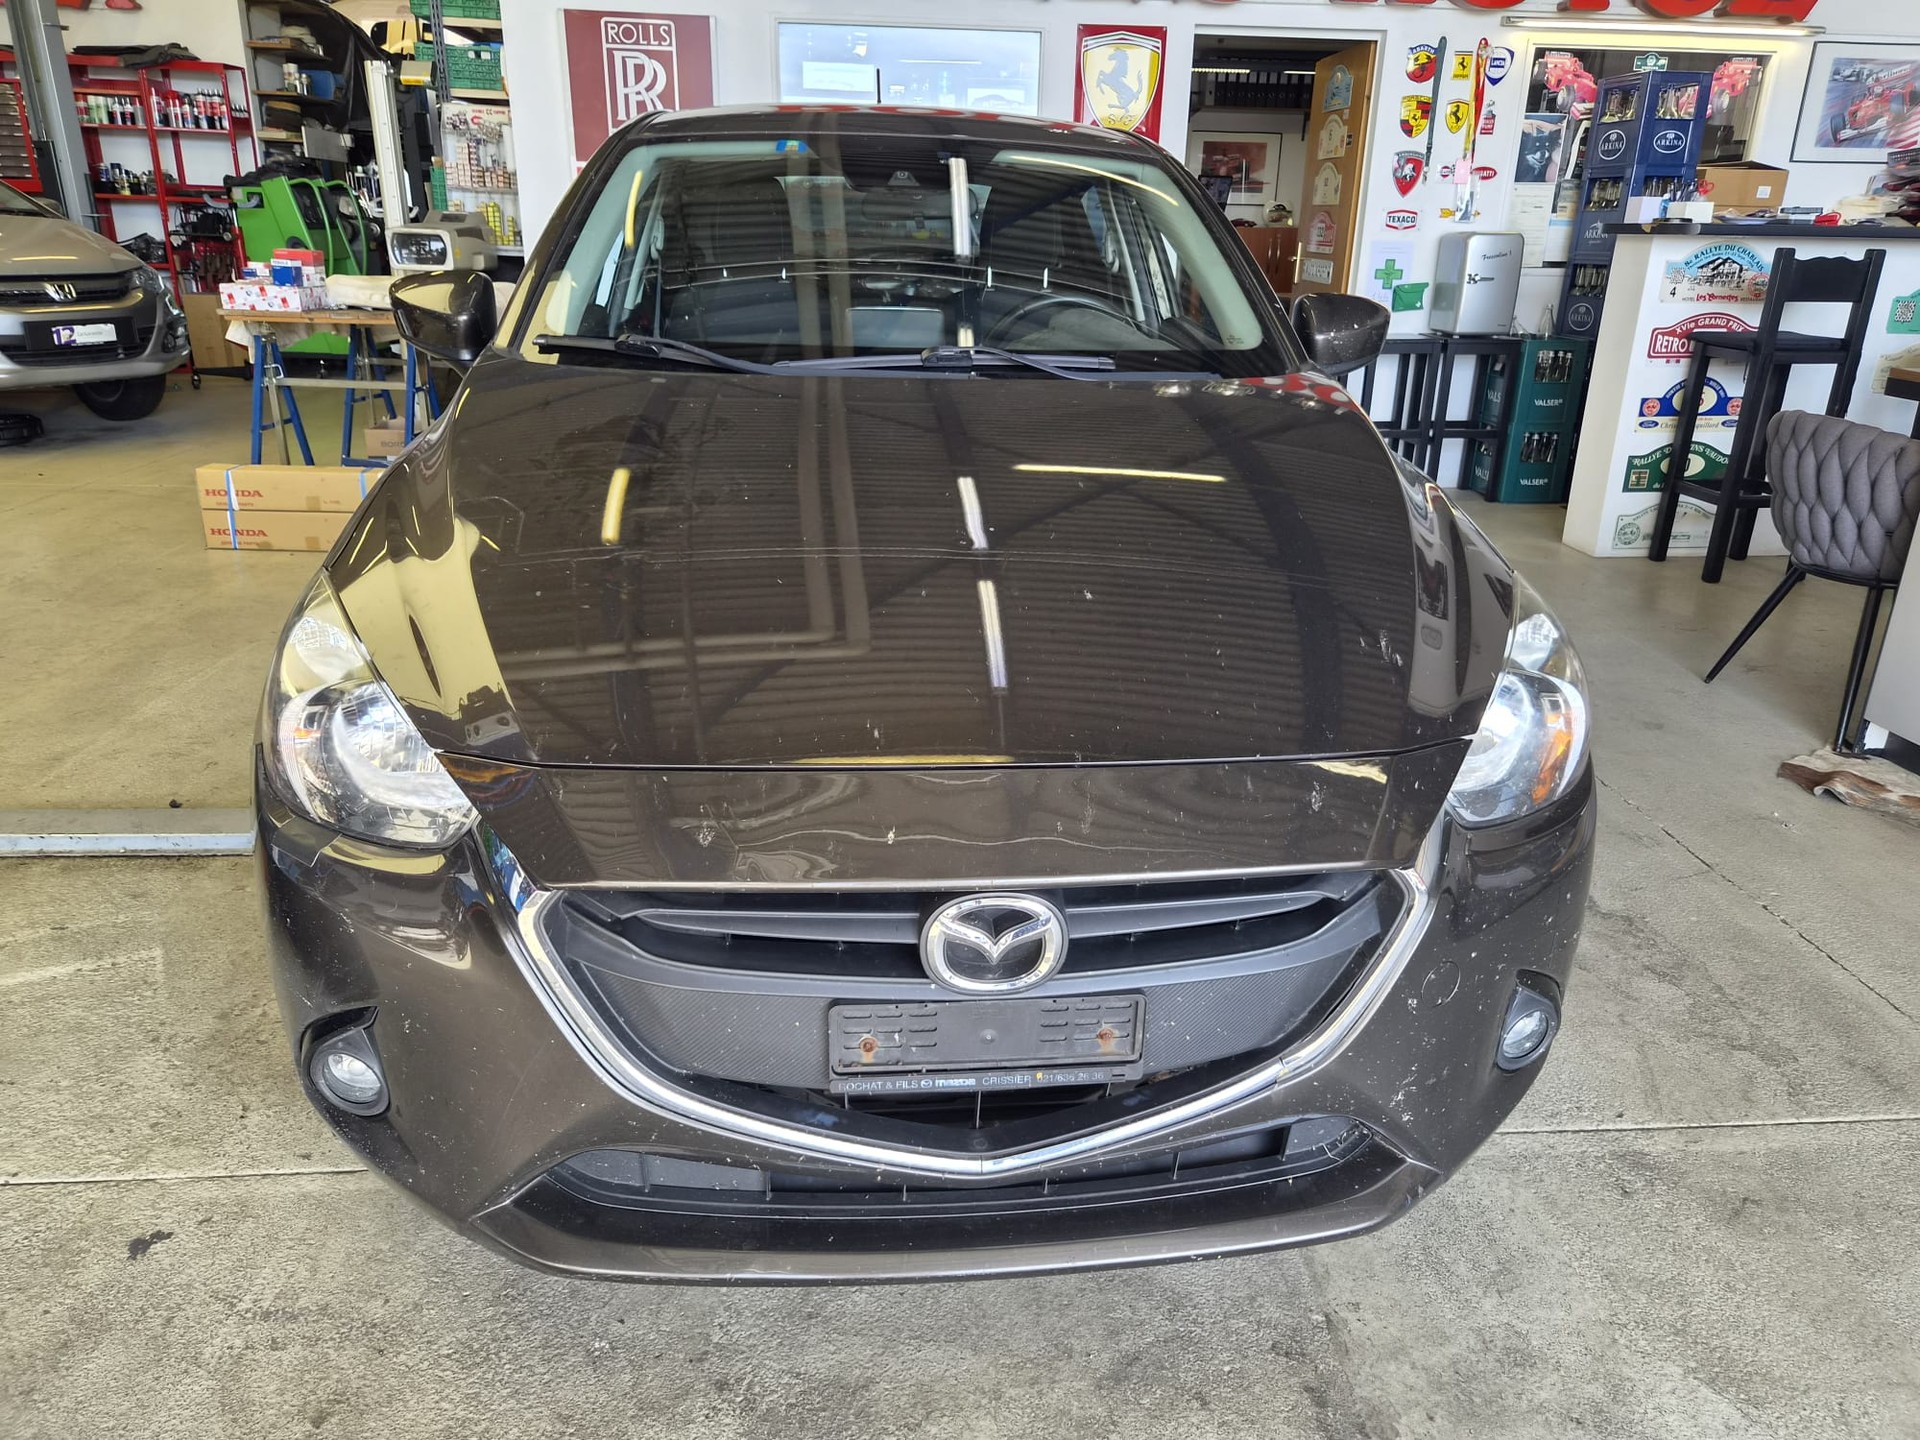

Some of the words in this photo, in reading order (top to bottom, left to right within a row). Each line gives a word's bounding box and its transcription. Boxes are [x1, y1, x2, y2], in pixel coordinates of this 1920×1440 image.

[607, 23, 670, 45] ROLLS
[1412, 45, 1435, 54] ABARTH
[1601, 142, 1623, 151] ARKINA
[1388, 215, 1416, 224] TEXACO
[1694, 245, 1721, 260] RALLYE
[1737, 246, 1764, 272] CHABLAIS
[1669, 286, 1677, 298] 4
[1696, 293, 1706, 302] Les
[1697, 317, 1727, 327] GRAND
[1727, 320, 1745, 332] PRIX
[1654, 334, 1688, 353] RETRO
[1632, 449, 1662, 466] RALLYE
[838, 1081, 883, 1091] ROCHAT
[896, 1081, 918, 1089] FILS
[982, 1075, 1031, 1086] CRISSIER
